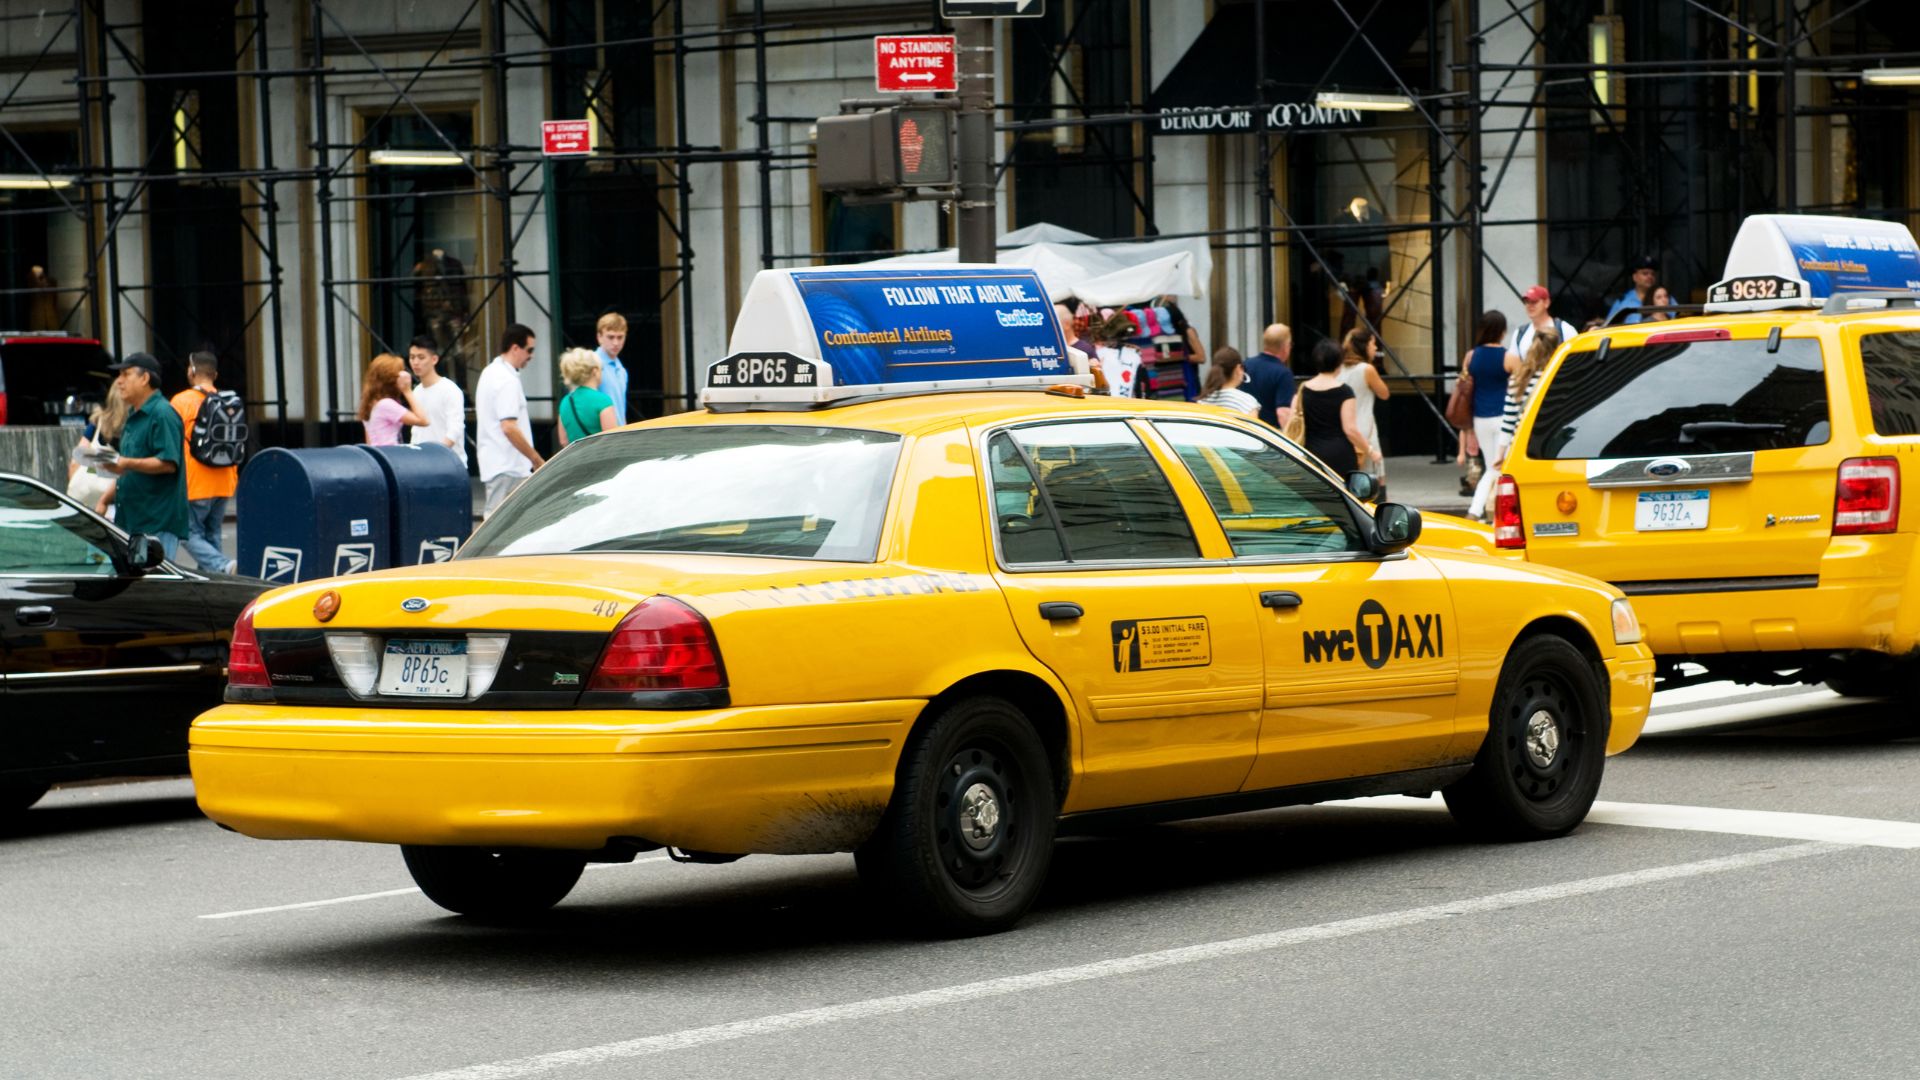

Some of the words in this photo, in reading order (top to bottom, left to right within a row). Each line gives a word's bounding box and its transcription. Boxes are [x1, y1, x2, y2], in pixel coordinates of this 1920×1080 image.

[880, 42, 896, 54] NO
[900, 41, 952, 54] STANDING
[889, 57, 944, 69] ANYTIME
[1267, 102, 1361, 127] OODMAN
[545, 125, 555, 133] NO
[556, 123, 588, 132] STANDING
[550, 132, 583, 141] ANYTIME
[1715, 286, 1727, 295] OFF
[1732, 279, 1777, 300] 9G32
[1782, 282, 1794, 290] OFF
[882, 287, 940, 306] FOLLOW
[939, 285, 975, 305] THAT
[977, 284, 1040, 304] AIRLINE...
[1713, 294, 1729, 302] DUTY
[1780, 289, 1797, 298] DUTY
[995, 309, 1044, 327] twitter
[823, 328, 901, 346] Continental
[903, 326, 953, 343] Airlines
[1023, 346, 1041, 357] Work
[1040, 345, 1058, 356] Hard.
[716, 364, 729, 374] OFF
[797, 364, 810, 374] OFF
[1031, 358, 1041, 371] Fly
[1041, 358, 1060, 370] Right.
[737, 358, 787, 384] 8P65
[713, 374, 732, 384] DUTY
[793, 373, 813, 383] DUTY
[1655, 493, 1671, 501] NEW
[1675, 492, 1691, 501] YORK
[1653, 502, 1691, 521] 9G32A
[405, 598, 427, 609] Ford
[593, 599, 618, 618] 48
[1141, 625, 1160, 635] $3.00
[1161, 624, 1186, 633] INITIAL
[1188, 622, 1205, 631] FARE
[1360, 607, 1444, 663] TAXI
[407, 643, 426, 654] NEW
[429, 643, 452, 655] YORK
[1303, 629, 1355, 664] NYC
